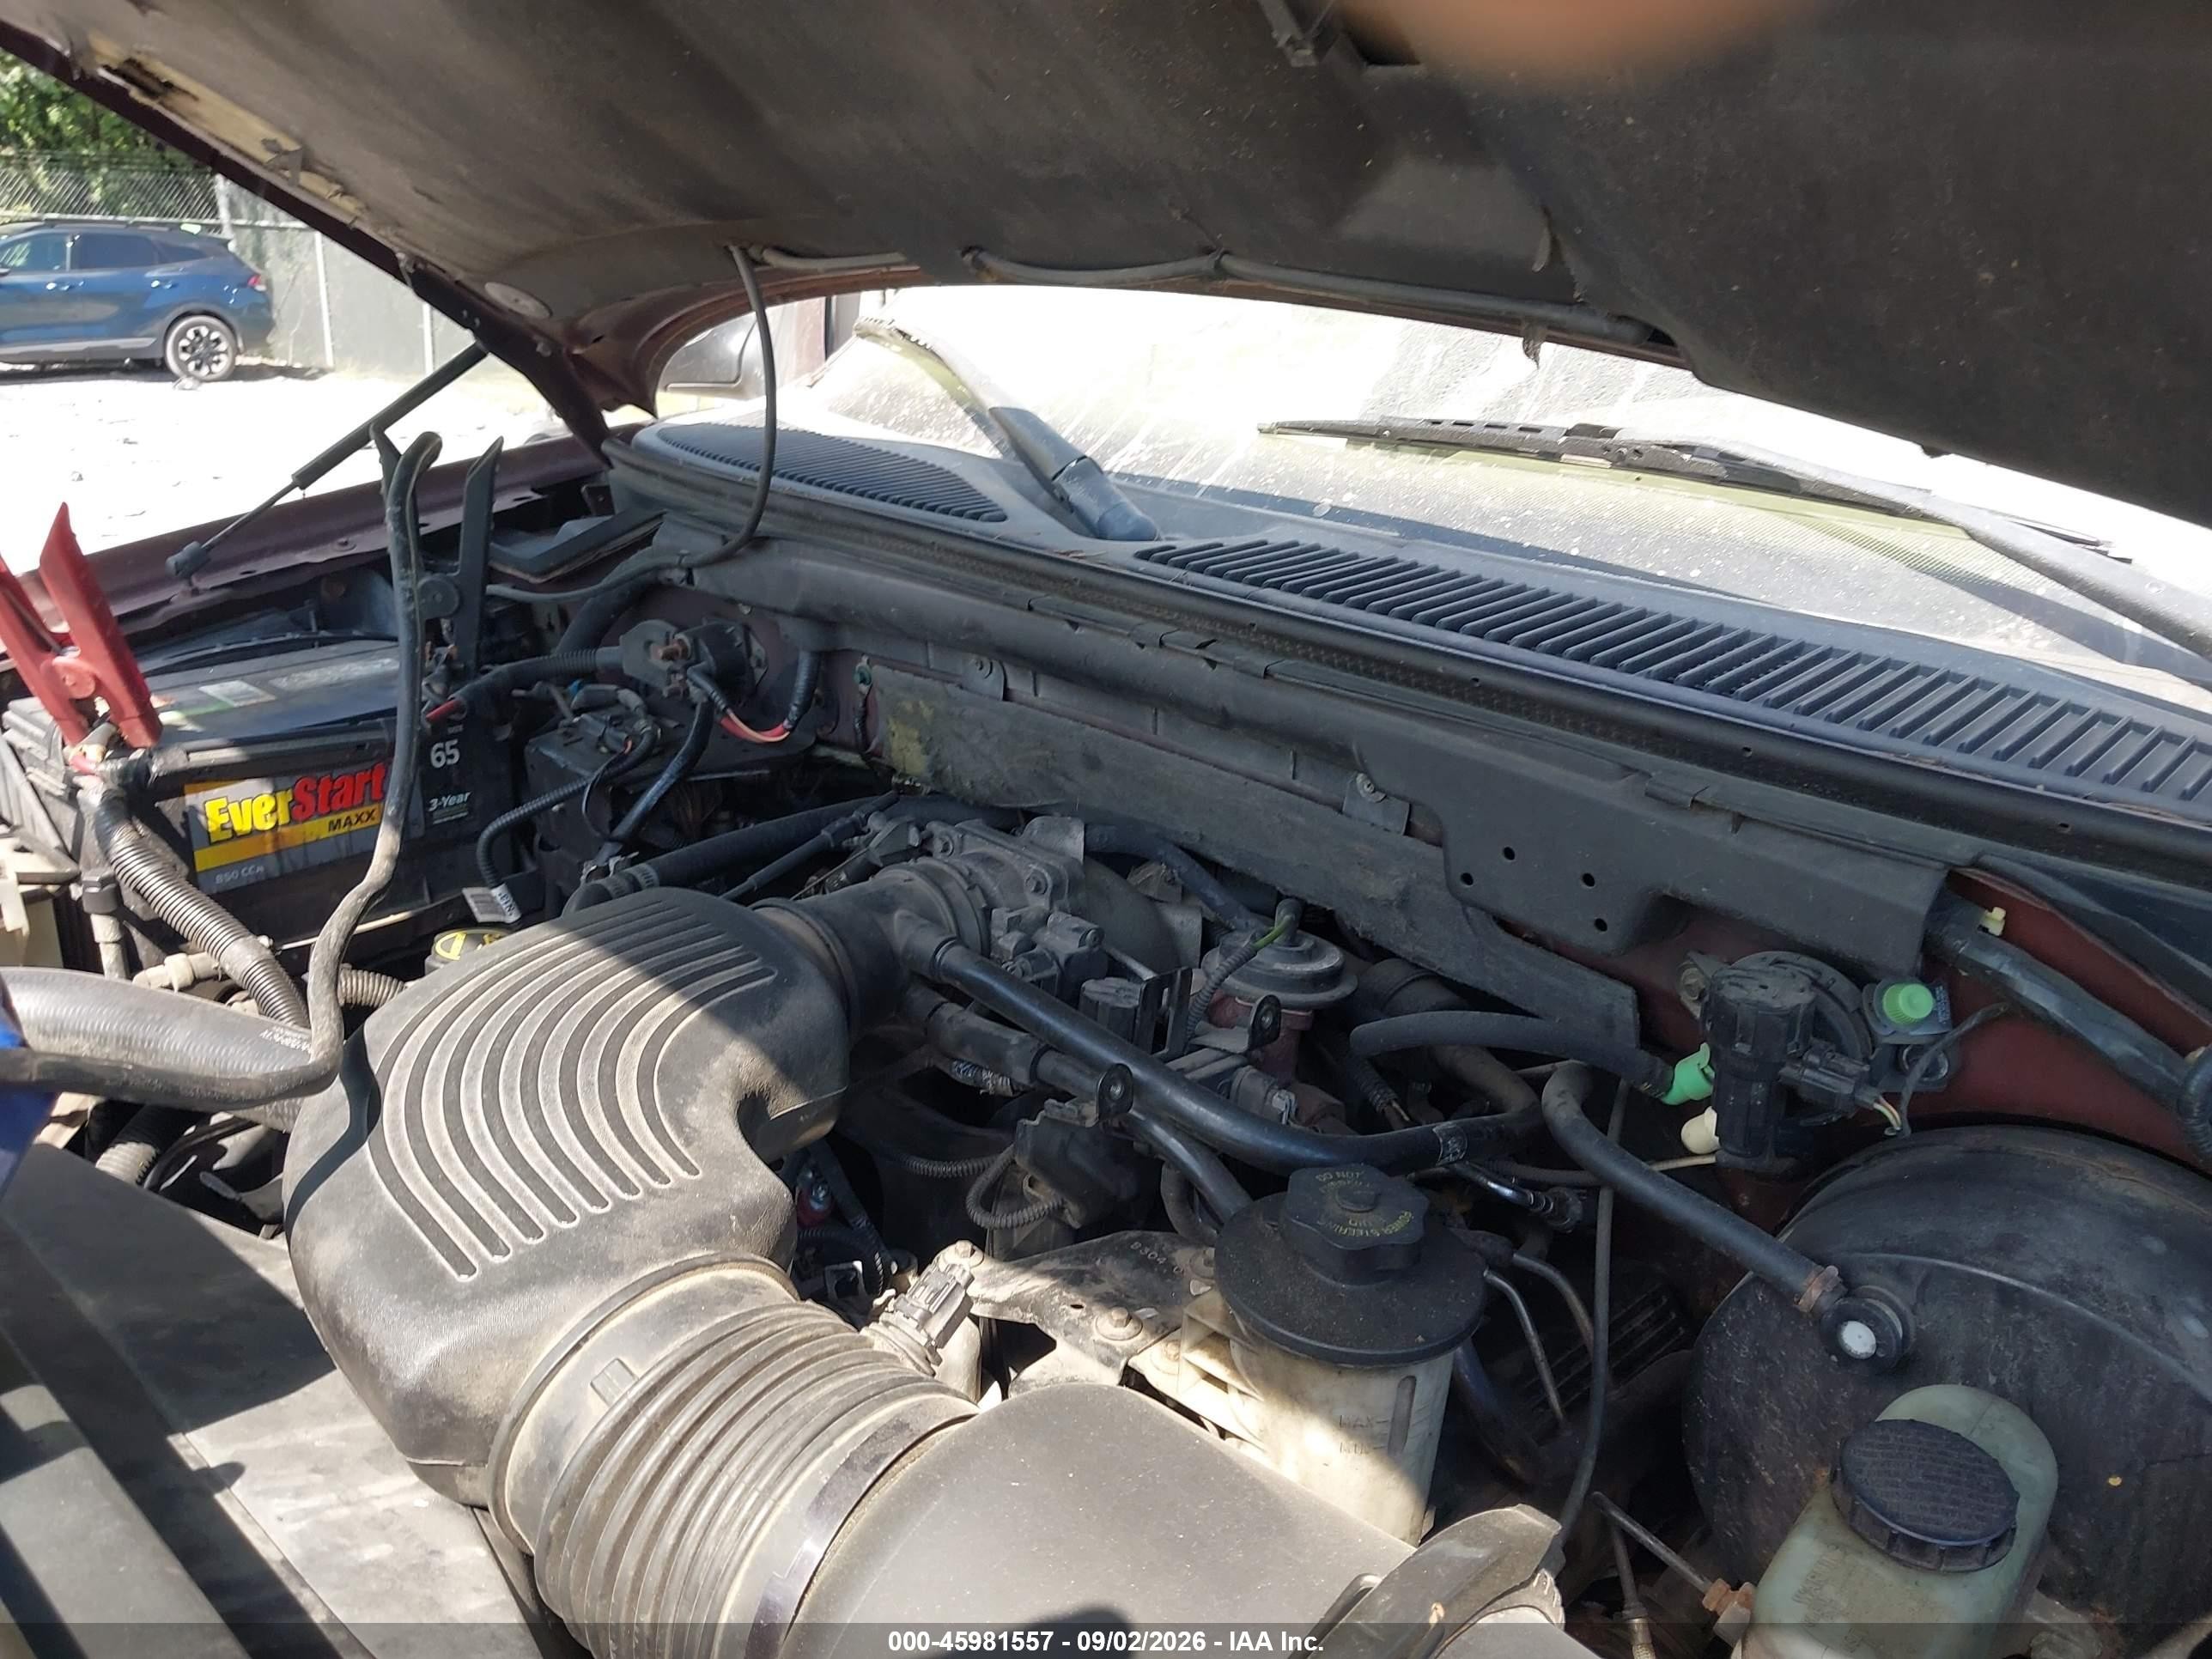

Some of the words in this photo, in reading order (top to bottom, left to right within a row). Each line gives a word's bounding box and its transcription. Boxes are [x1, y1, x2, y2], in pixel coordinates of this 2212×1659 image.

[430, 738, 460, 769] 65
[204, 762, 386, 845] EverStart
[428, 791, 472, 811] 3-Year
[328, 807, 377, 832] MAXX
